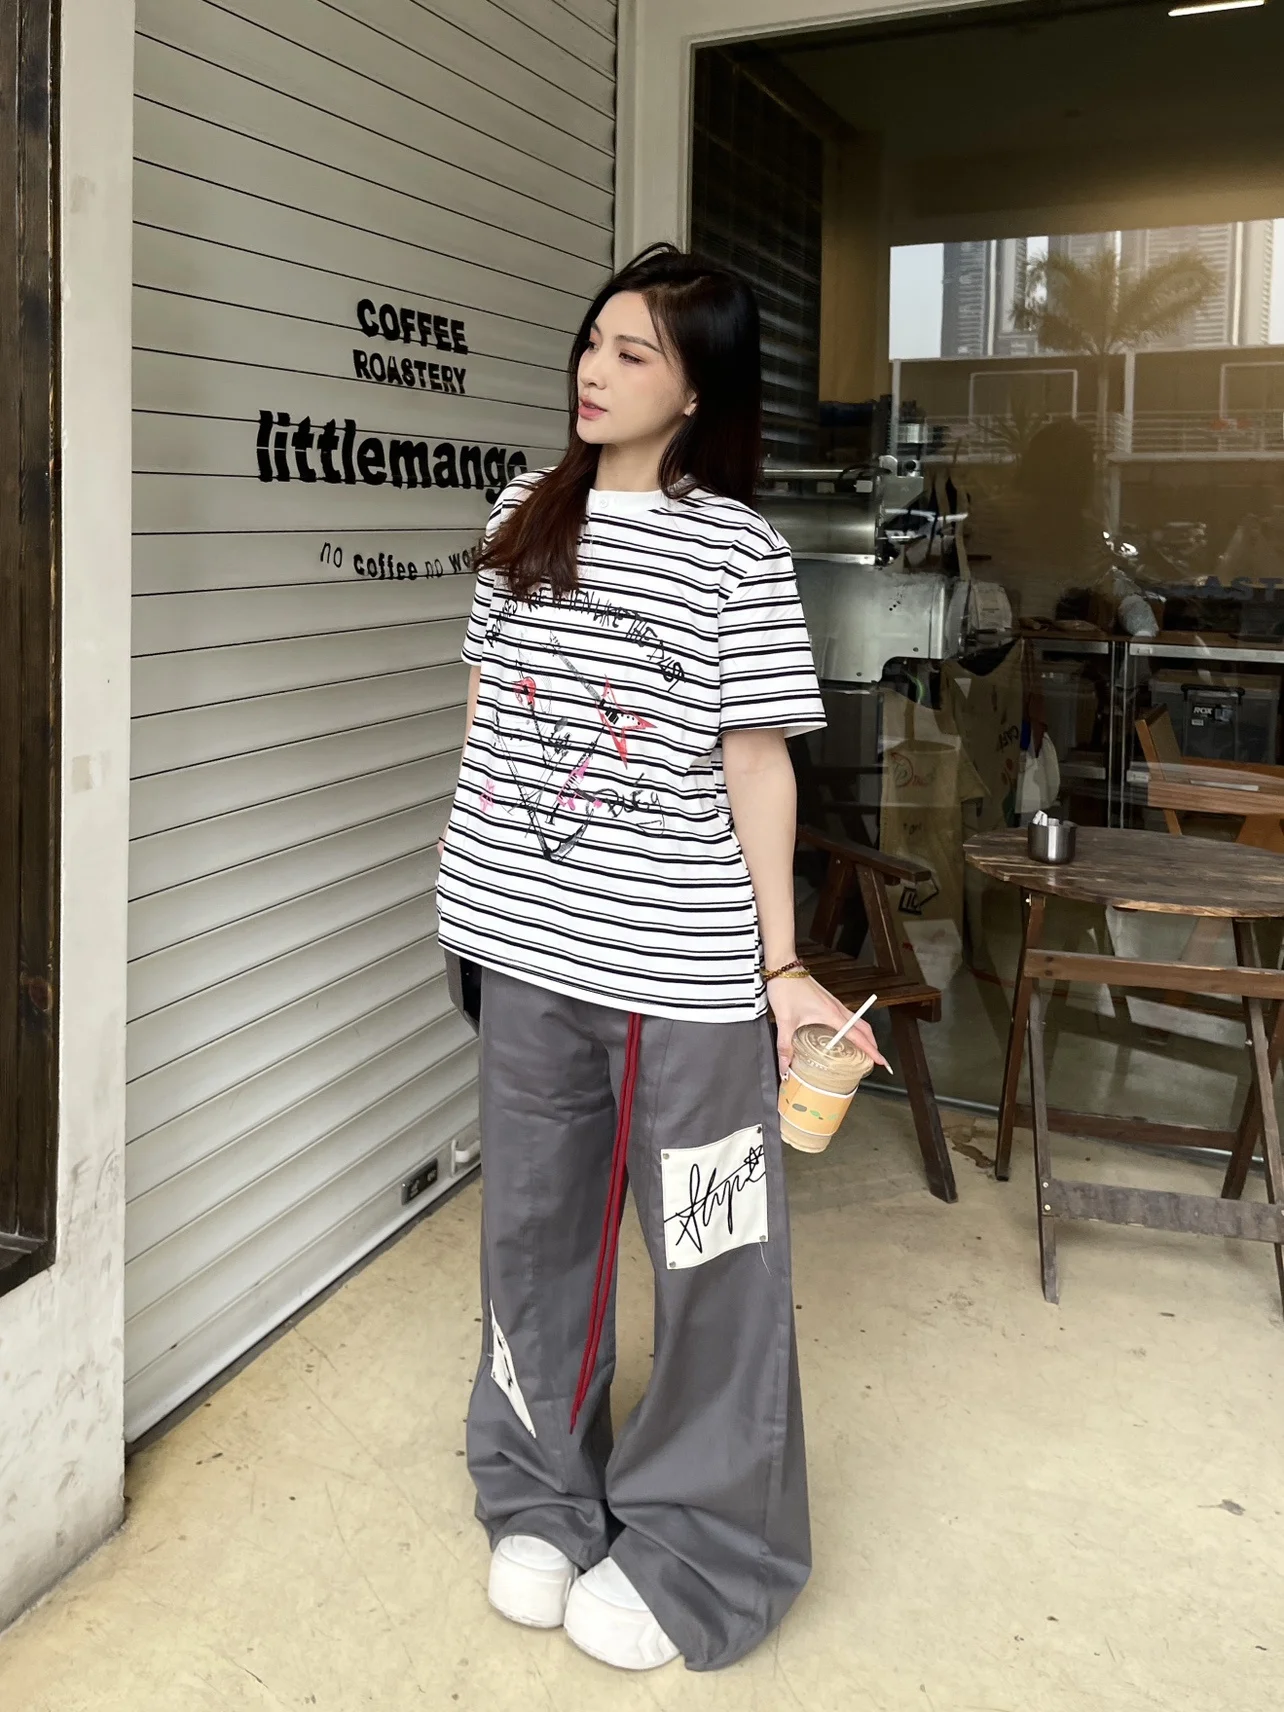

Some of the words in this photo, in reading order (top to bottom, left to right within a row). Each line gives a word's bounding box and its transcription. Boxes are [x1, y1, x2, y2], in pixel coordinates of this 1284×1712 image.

[356, 299, 468, 355] COFFEE
[352, 349, 467, 394] ROASTERY
[257, 410, 527, 504] littlemango
[320, 541, 343, 568] no
[353, 552, 418, 580] coffee
[424, 558, 444, 579] no
